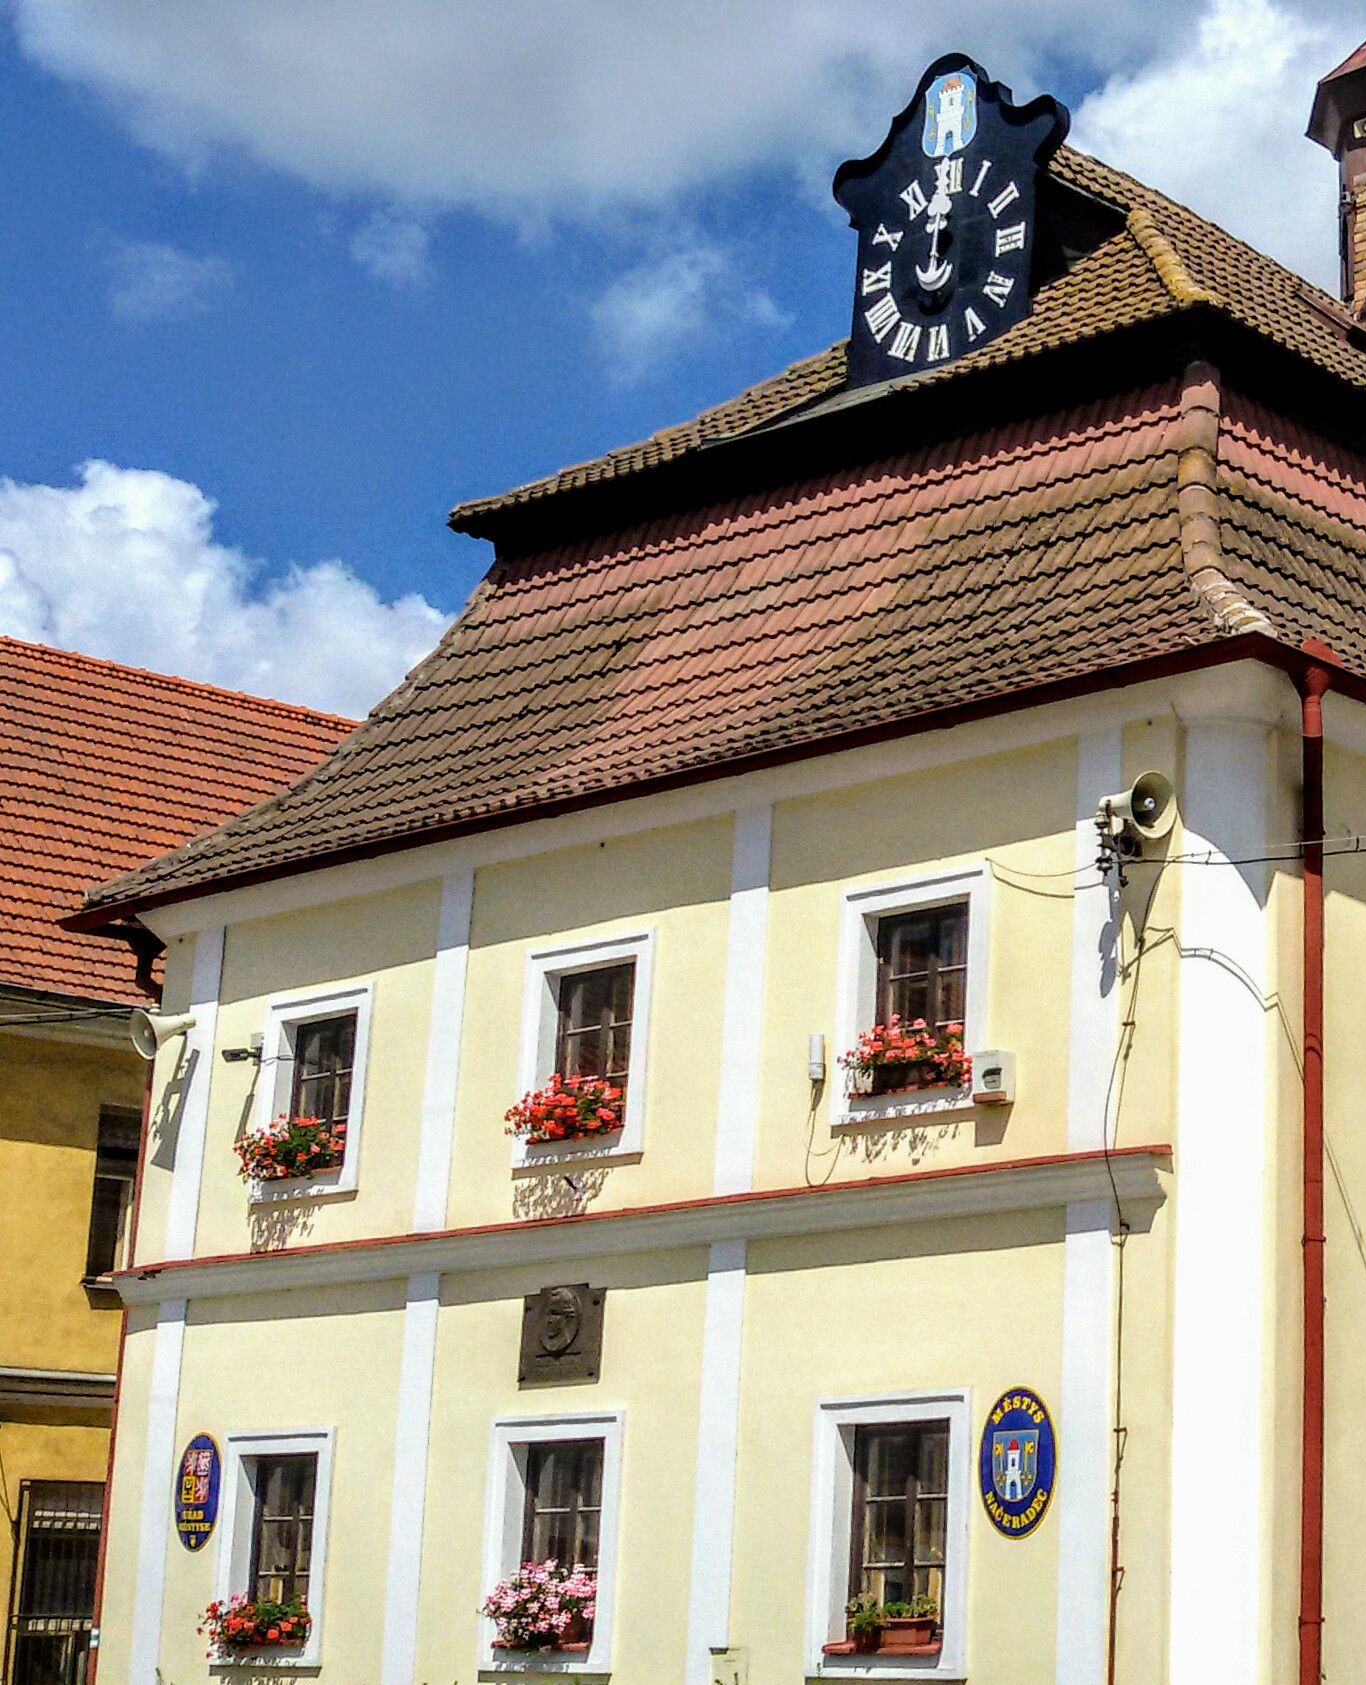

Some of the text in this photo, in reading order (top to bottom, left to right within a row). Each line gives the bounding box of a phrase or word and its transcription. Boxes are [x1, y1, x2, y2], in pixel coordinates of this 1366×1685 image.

[968, 159, 992, 197] I
[900, 179, 929, 221] XI
[987, 181, 1020, 219] II
[872, 223, 904, 251] X
[995, 221, 1026, 257] III
[862, 261, 892, 296] IX
[982, 270, 1015, 307] IV
[864, 292, 901, 344] VIII
[964, 306, 987, 342] V
[887, 321, 922, 362] VII
[927, 324, 950, 362] VI
[991, 1395, 1044, 1425] MĚSTYS
